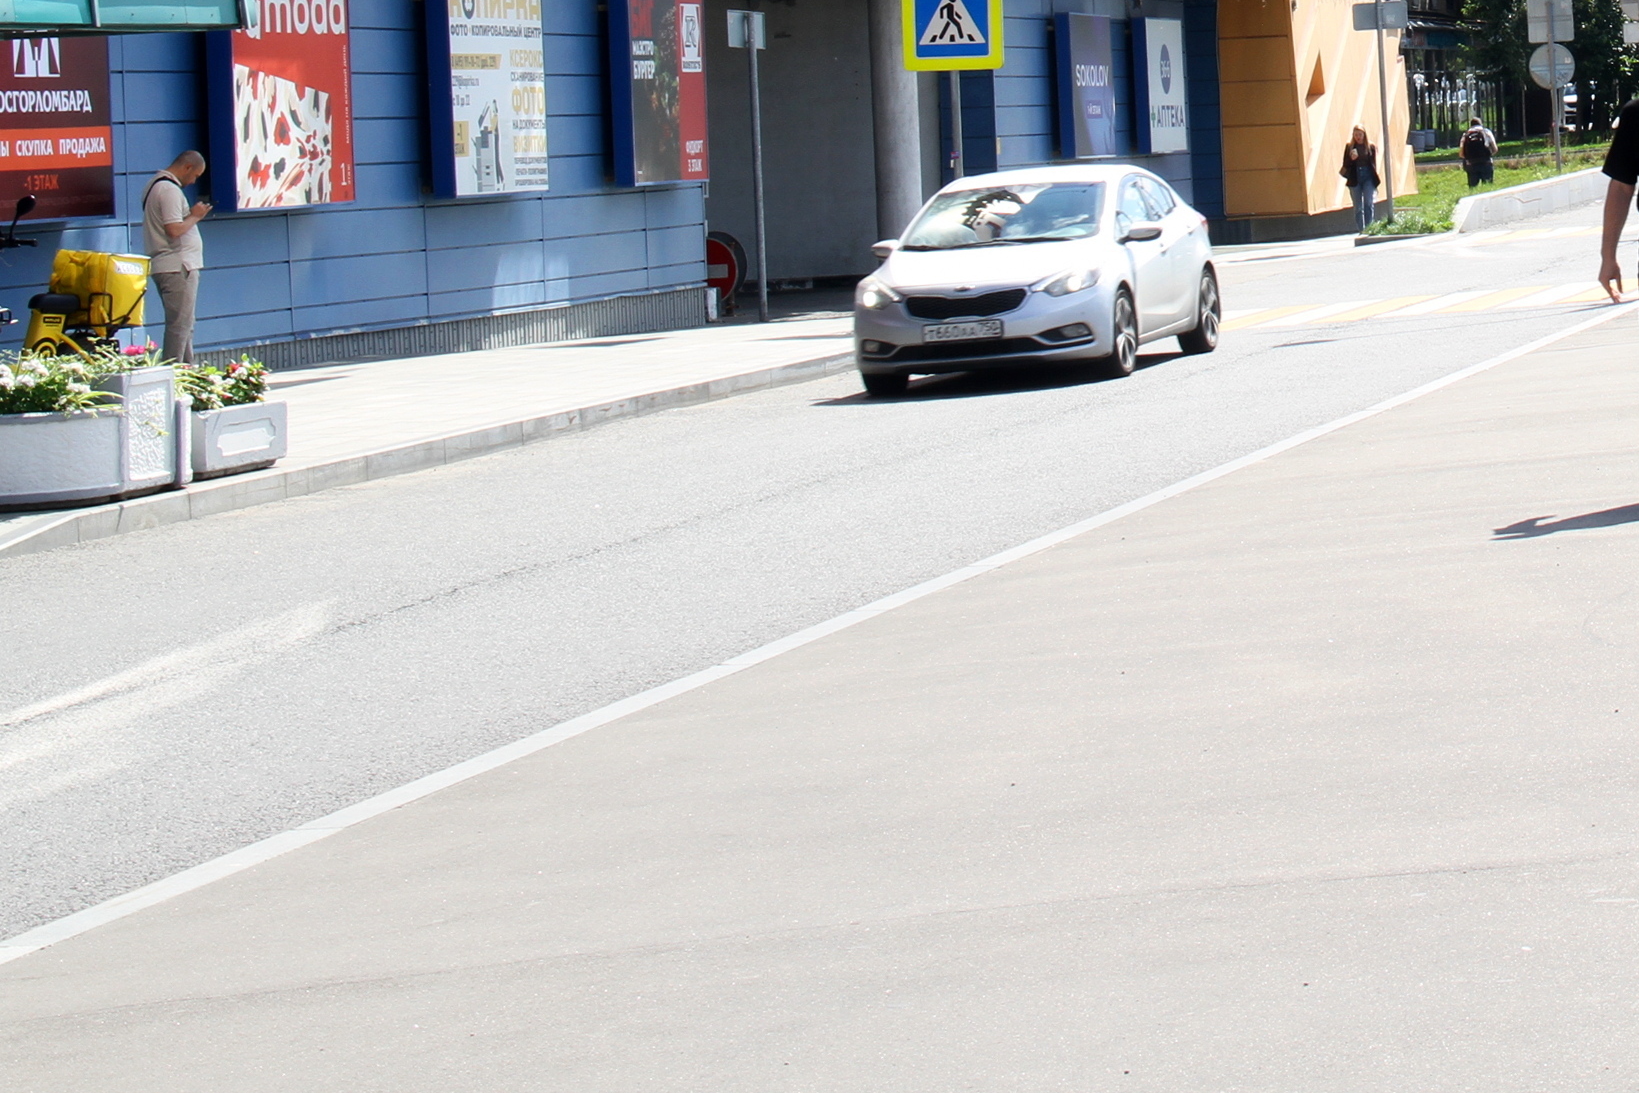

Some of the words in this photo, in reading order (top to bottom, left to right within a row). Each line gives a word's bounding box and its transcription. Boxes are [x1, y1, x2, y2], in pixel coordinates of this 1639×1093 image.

[450, 24, 468, 36] ФОТО
[471, 24, 522, 37] КОПИРОВАЛЬНЫЙ
[523, 26, 541, 39] ЦЕНТР
[509, 49, 543, 68] КСЕРОКС
[510, 71, 544, 82] СКАНИРОВАНИЕ
[633, 60, 655, 80] БУРГЕР
[1075, 64, 1109, 87] SOKOLOV
[512, 86, 545, 116] ФОТО
[1157, 105, 1185, 129] АПТЕКА
[16, 139, 54, 157] СКУПКА
[59, 137, 106, 159] ПРОДАЖА
[513, 135, 547, 153] ВИЗИТКИ
[24, 175, 32, 191] -1
[33, 174, 59, 190] ЭТАЖ
